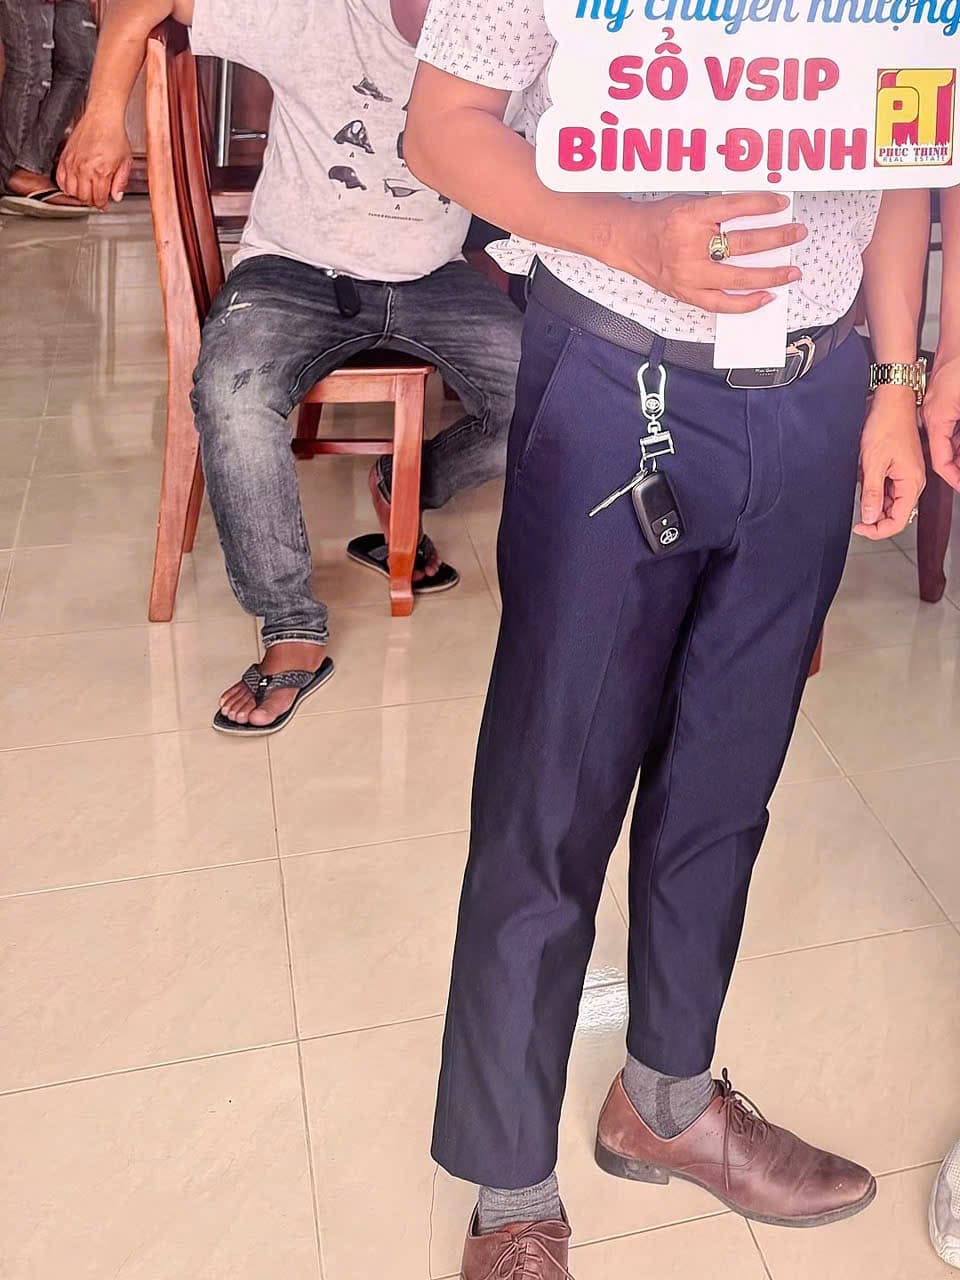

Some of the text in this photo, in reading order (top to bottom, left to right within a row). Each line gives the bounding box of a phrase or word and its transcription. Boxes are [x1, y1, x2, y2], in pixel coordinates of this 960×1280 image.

[607, 27, 840, 102] SỔ VSIP
[558, 111, 868, 184] BÌNH ĐỊNH
[914, 154, 946, 163] ESTATE
